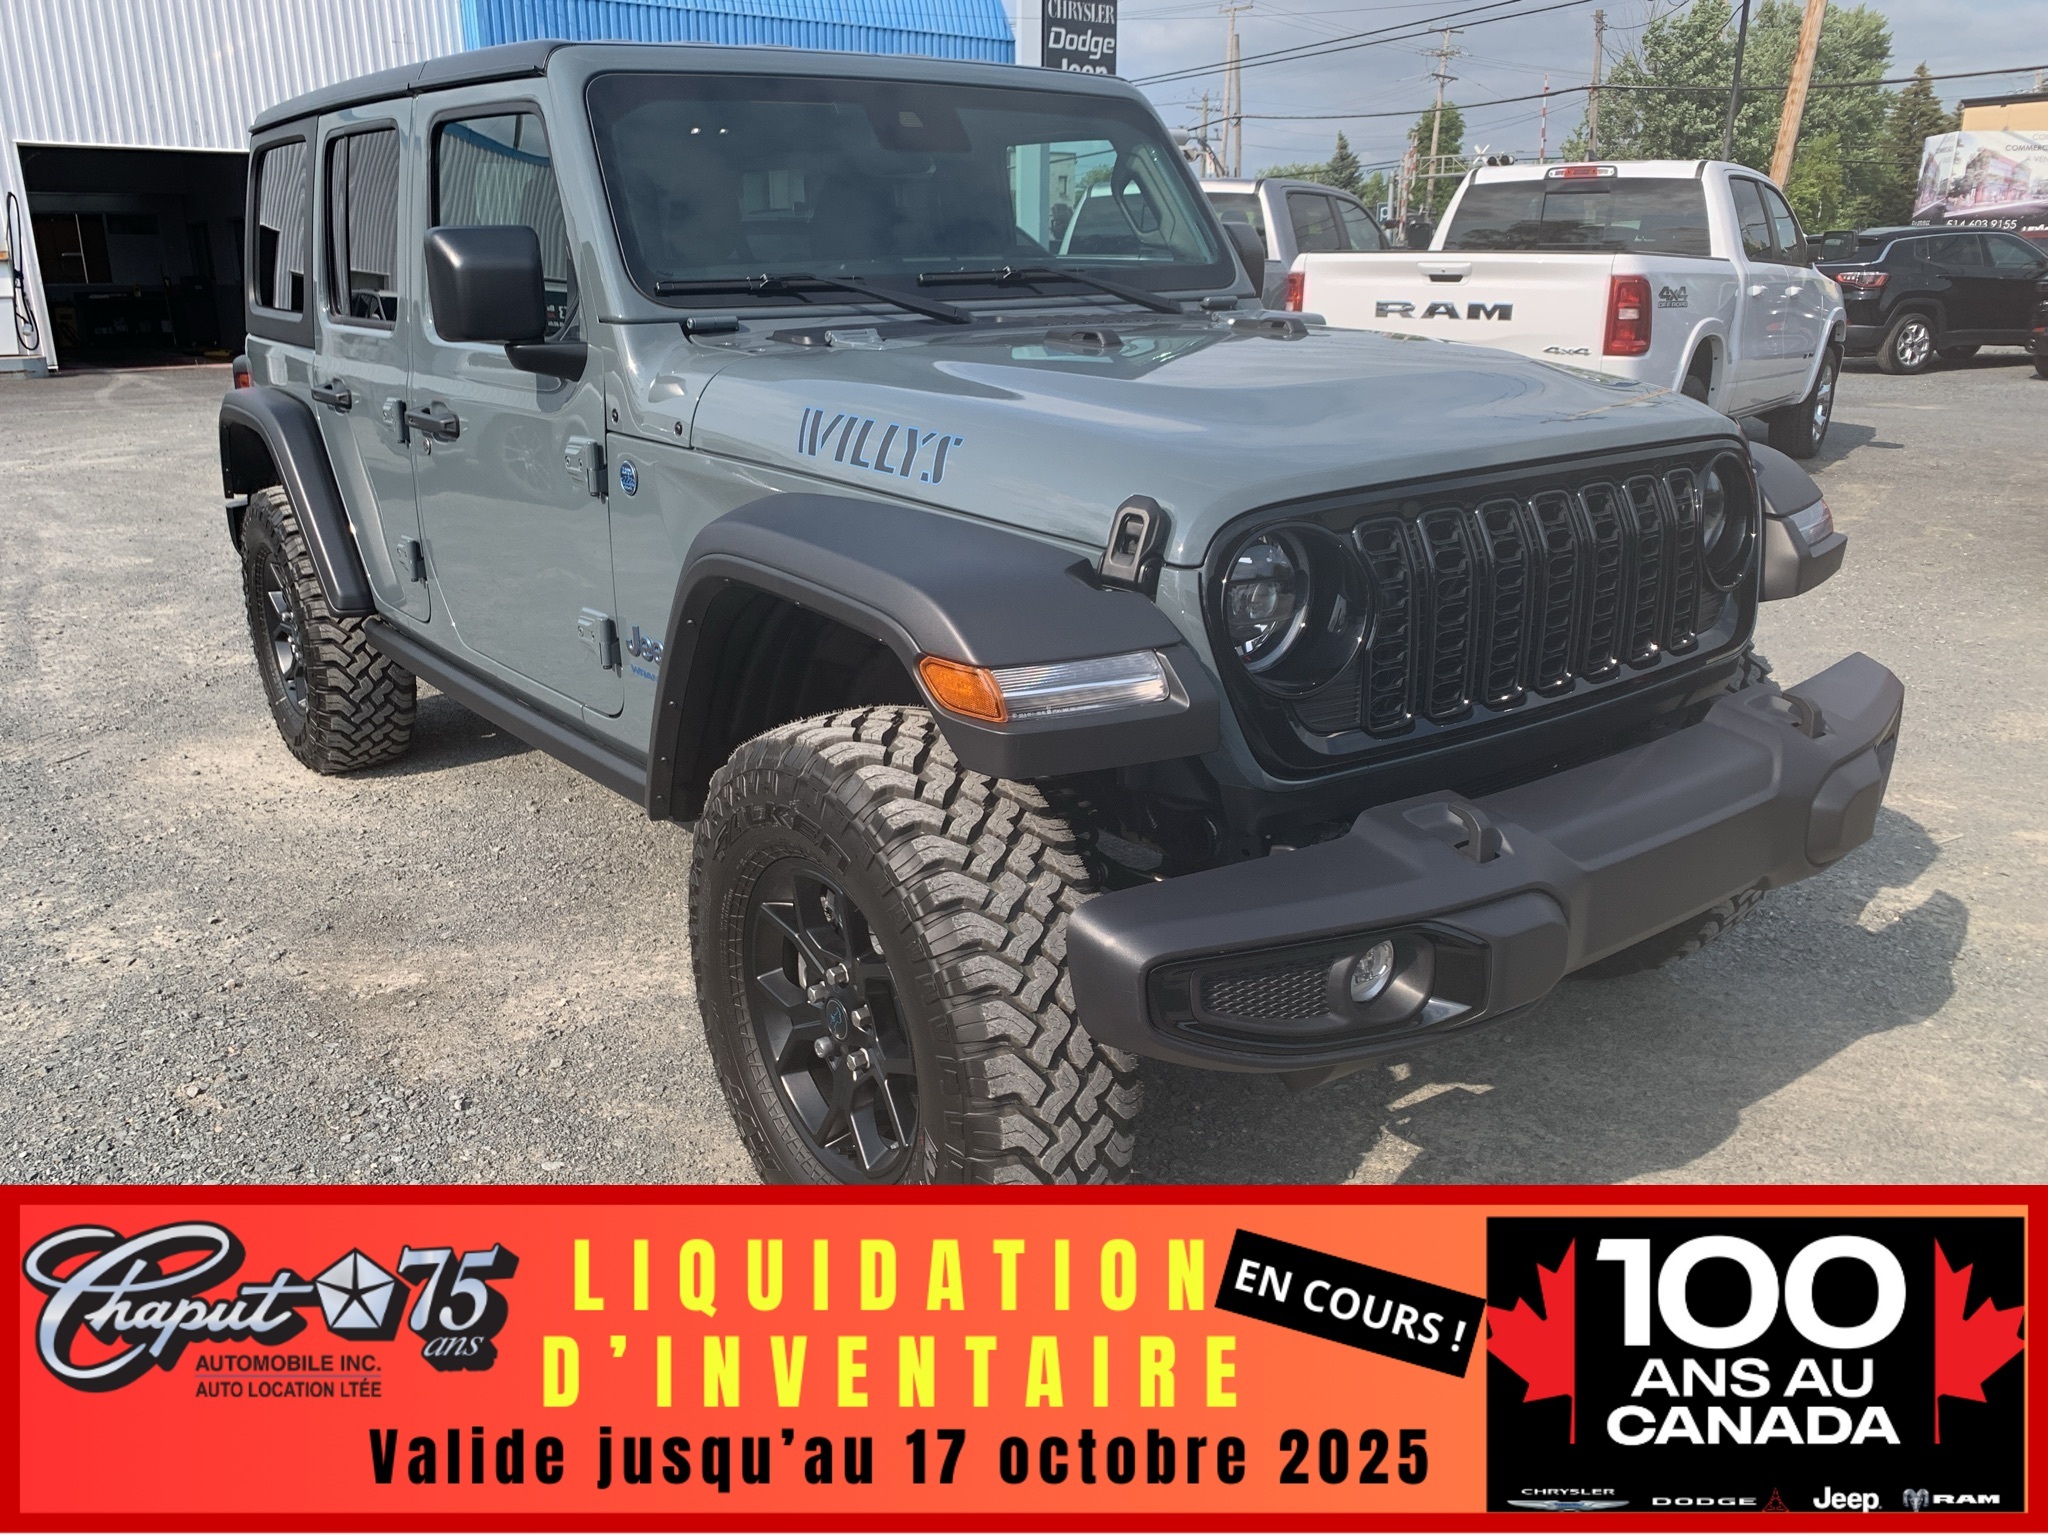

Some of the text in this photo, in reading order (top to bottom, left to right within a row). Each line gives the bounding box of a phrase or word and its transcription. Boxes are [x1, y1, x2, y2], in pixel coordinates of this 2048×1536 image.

[1047, 0, 1115, 24] CHRYSLER
[1048, 26, 1115, 60] Dodge
[1990, 219, 2018, 230] 9155
[1375, 301, 1514, 321] RAM
[798, 407, 966, 486] WILLYS
[625, 625, 665, 667] Jee
